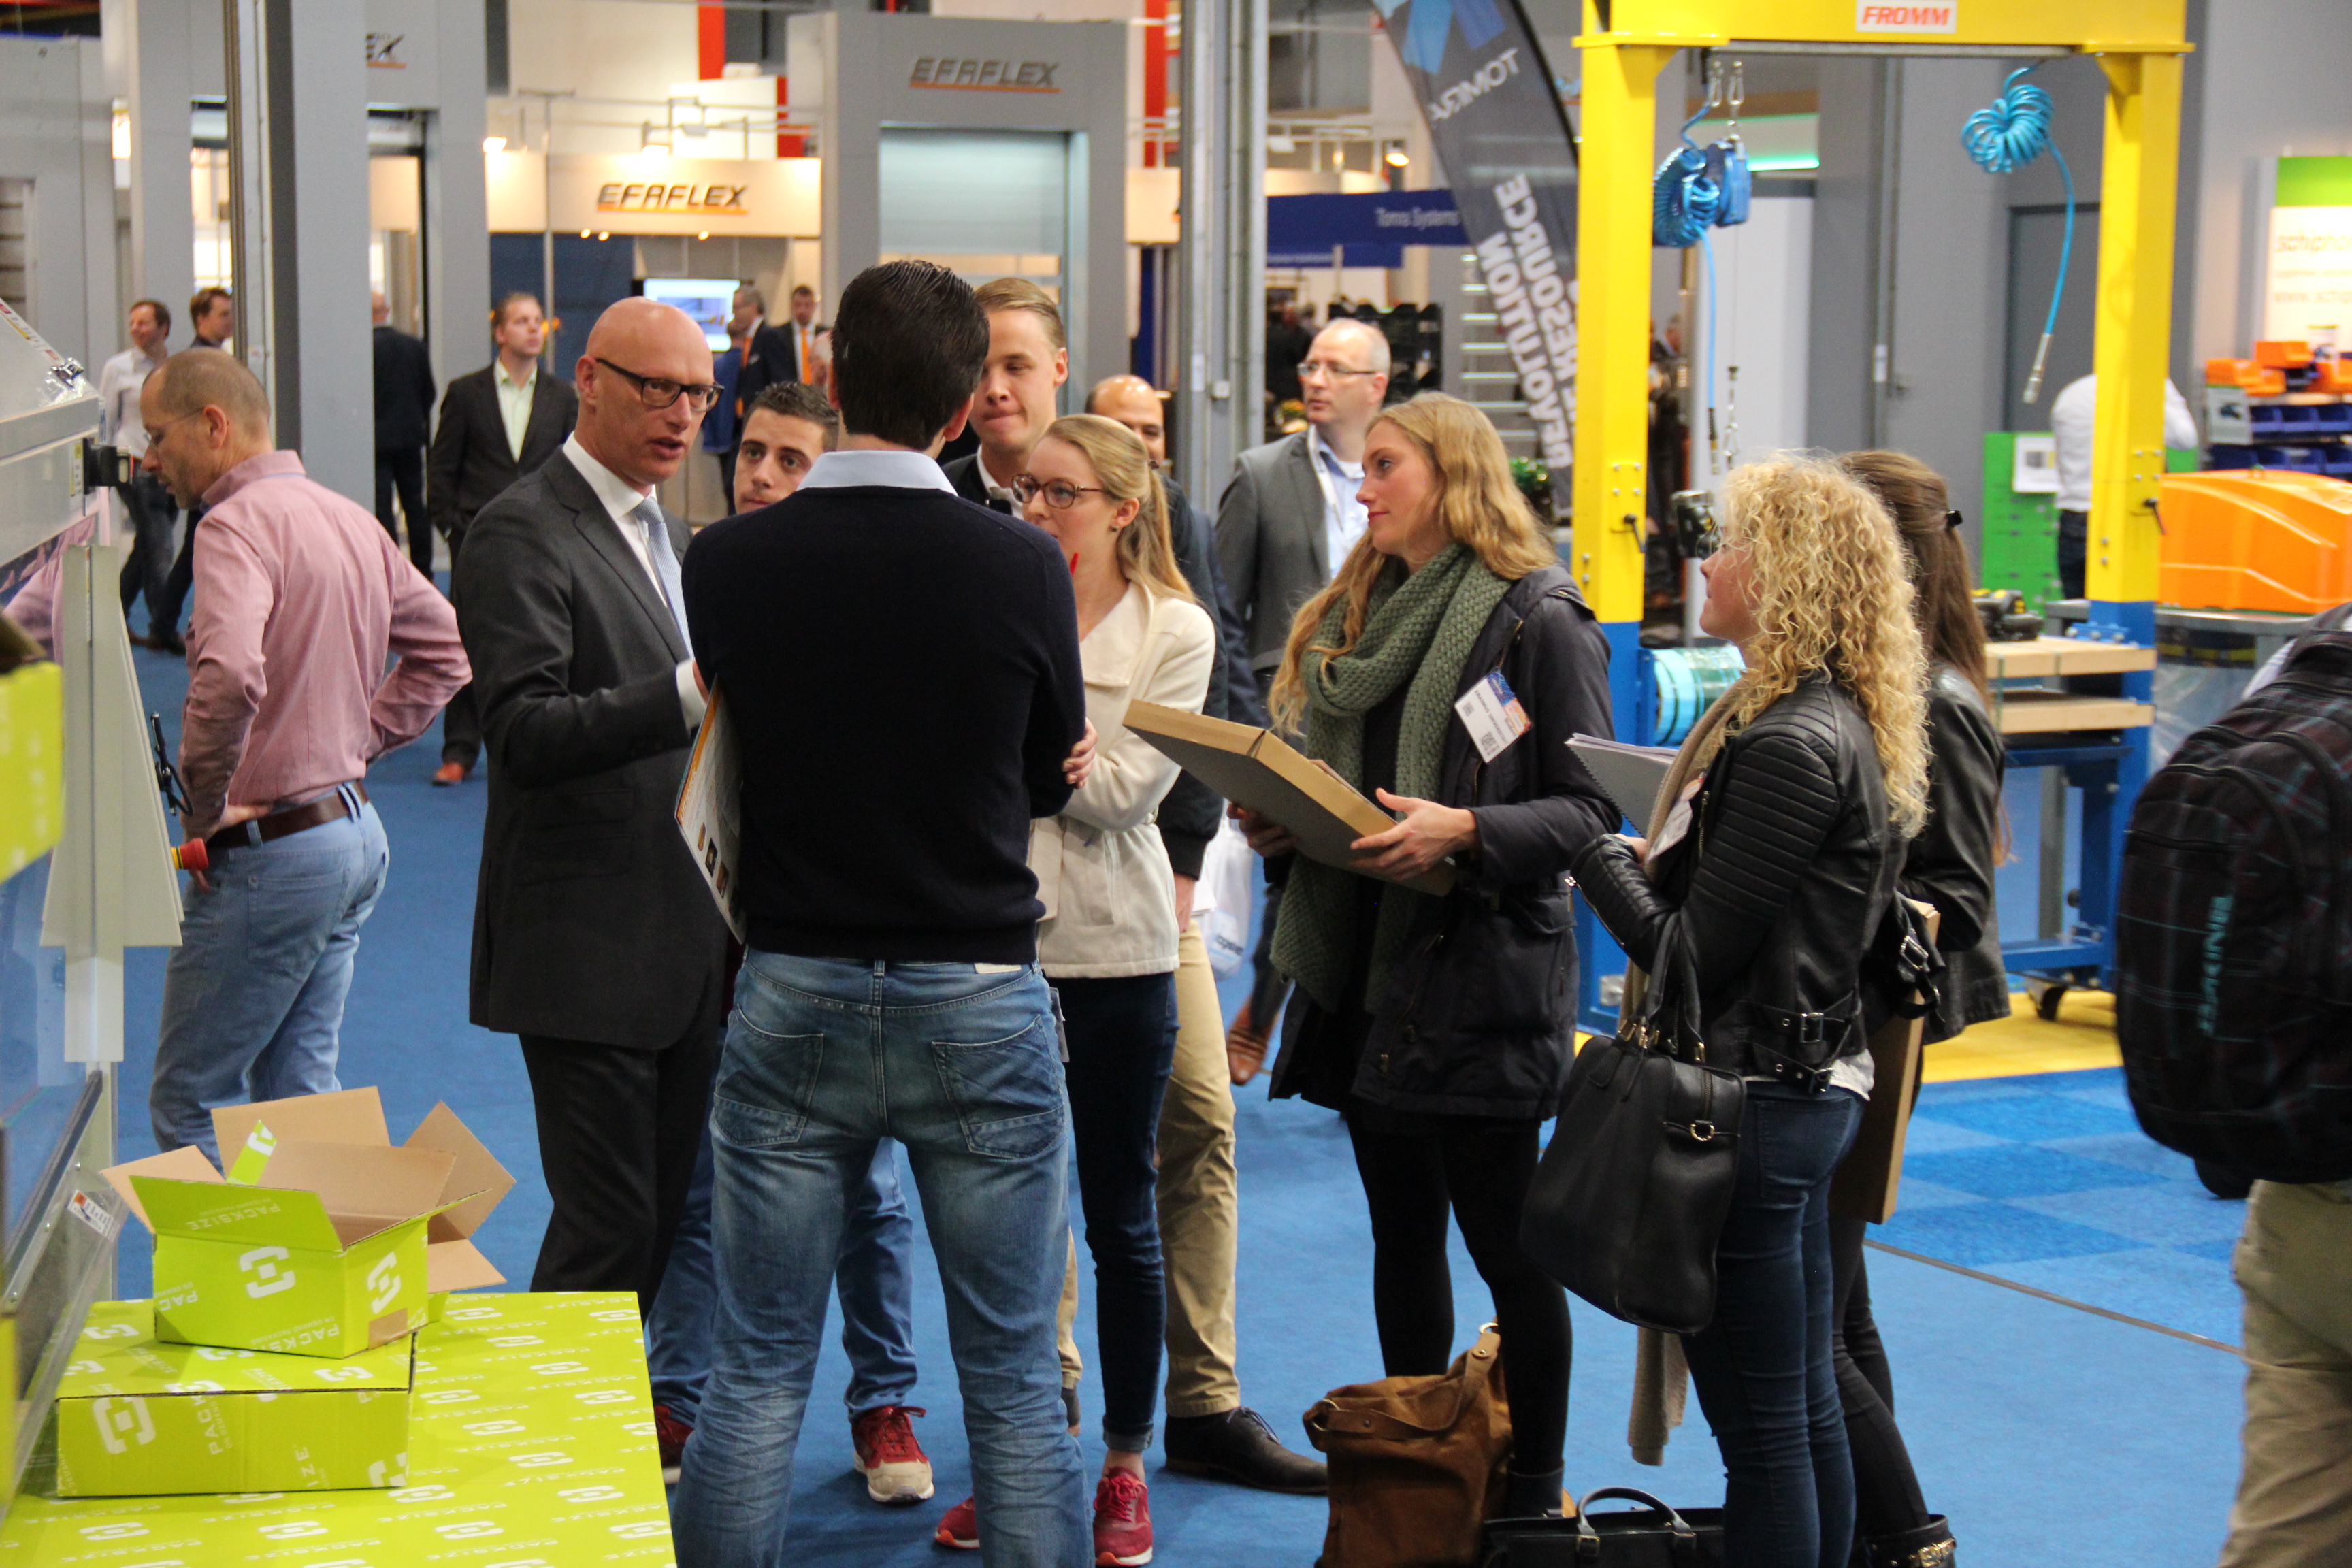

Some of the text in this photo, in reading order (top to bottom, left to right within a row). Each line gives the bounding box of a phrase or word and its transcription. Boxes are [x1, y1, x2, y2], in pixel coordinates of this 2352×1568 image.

[1861, 5, 1951, 26] FROMM
[911, 57, 1060, 88] EFAFLEX
[597, 182, 748, 208] EFAFLEX
[186, 1203, 281, 1230] PACKSIZE
